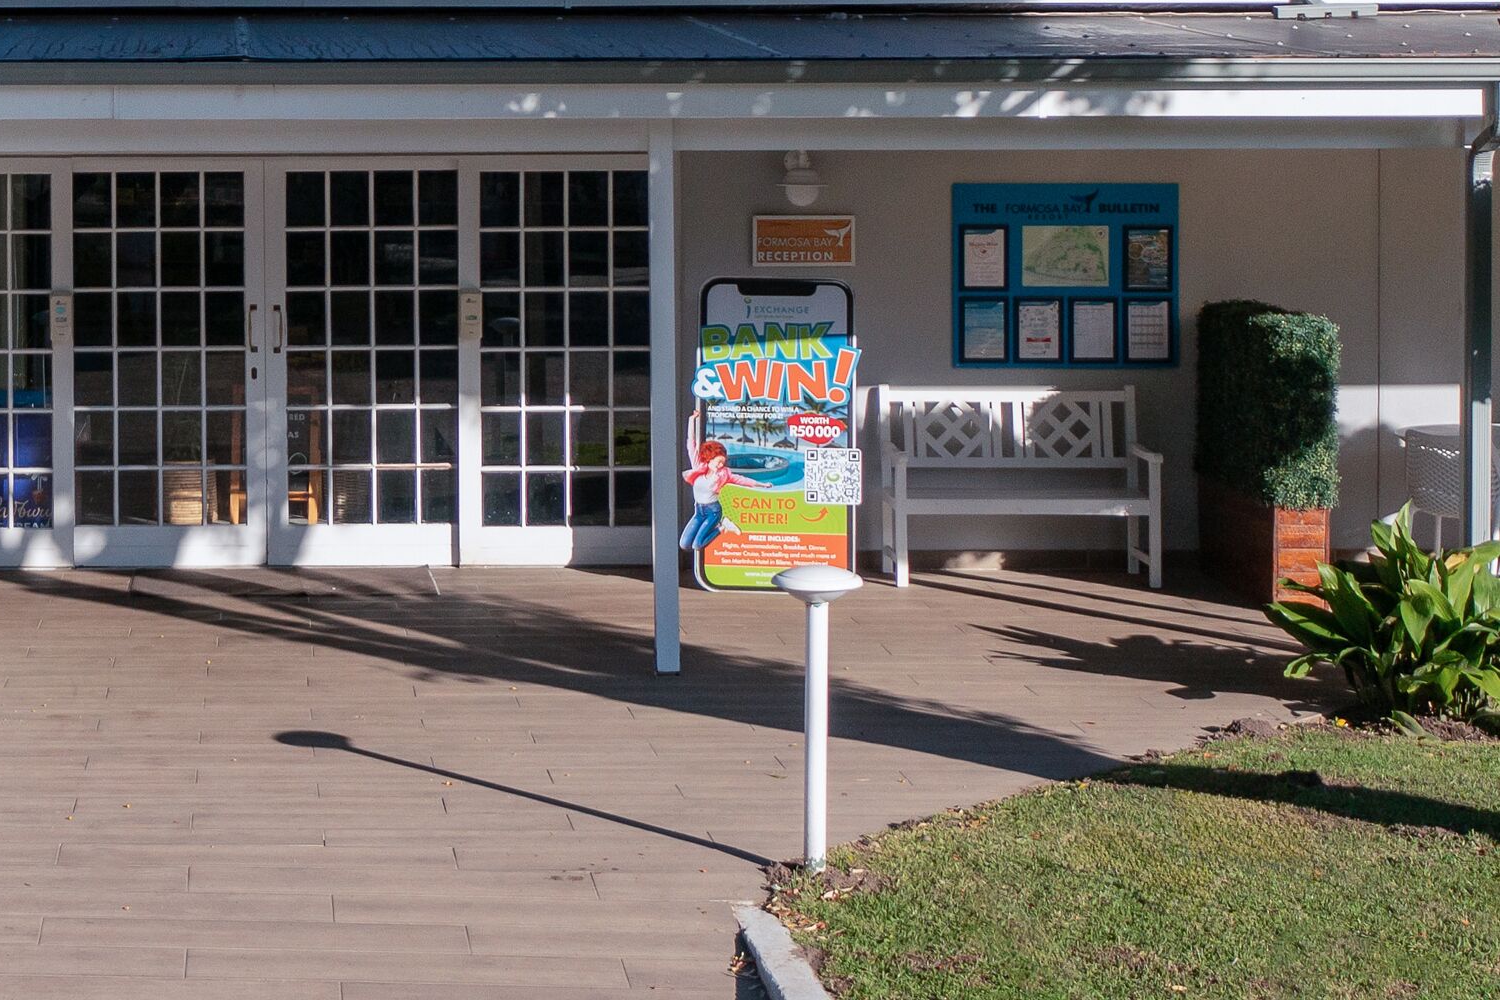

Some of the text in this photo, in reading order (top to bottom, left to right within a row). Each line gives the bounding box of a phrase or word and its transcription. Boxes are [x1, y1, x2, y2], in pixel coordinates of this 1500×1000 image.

[757, 236, 833, 248] FORMOSA BAY
[757, 251, 834, 262] RECEPTION
[700, 321, 836, 361] BANK
[800, 416, 830, 425] WORTH
[732, 497, 796, 510] SCAN TO
[740, 512, 788, 524] ENTER!
